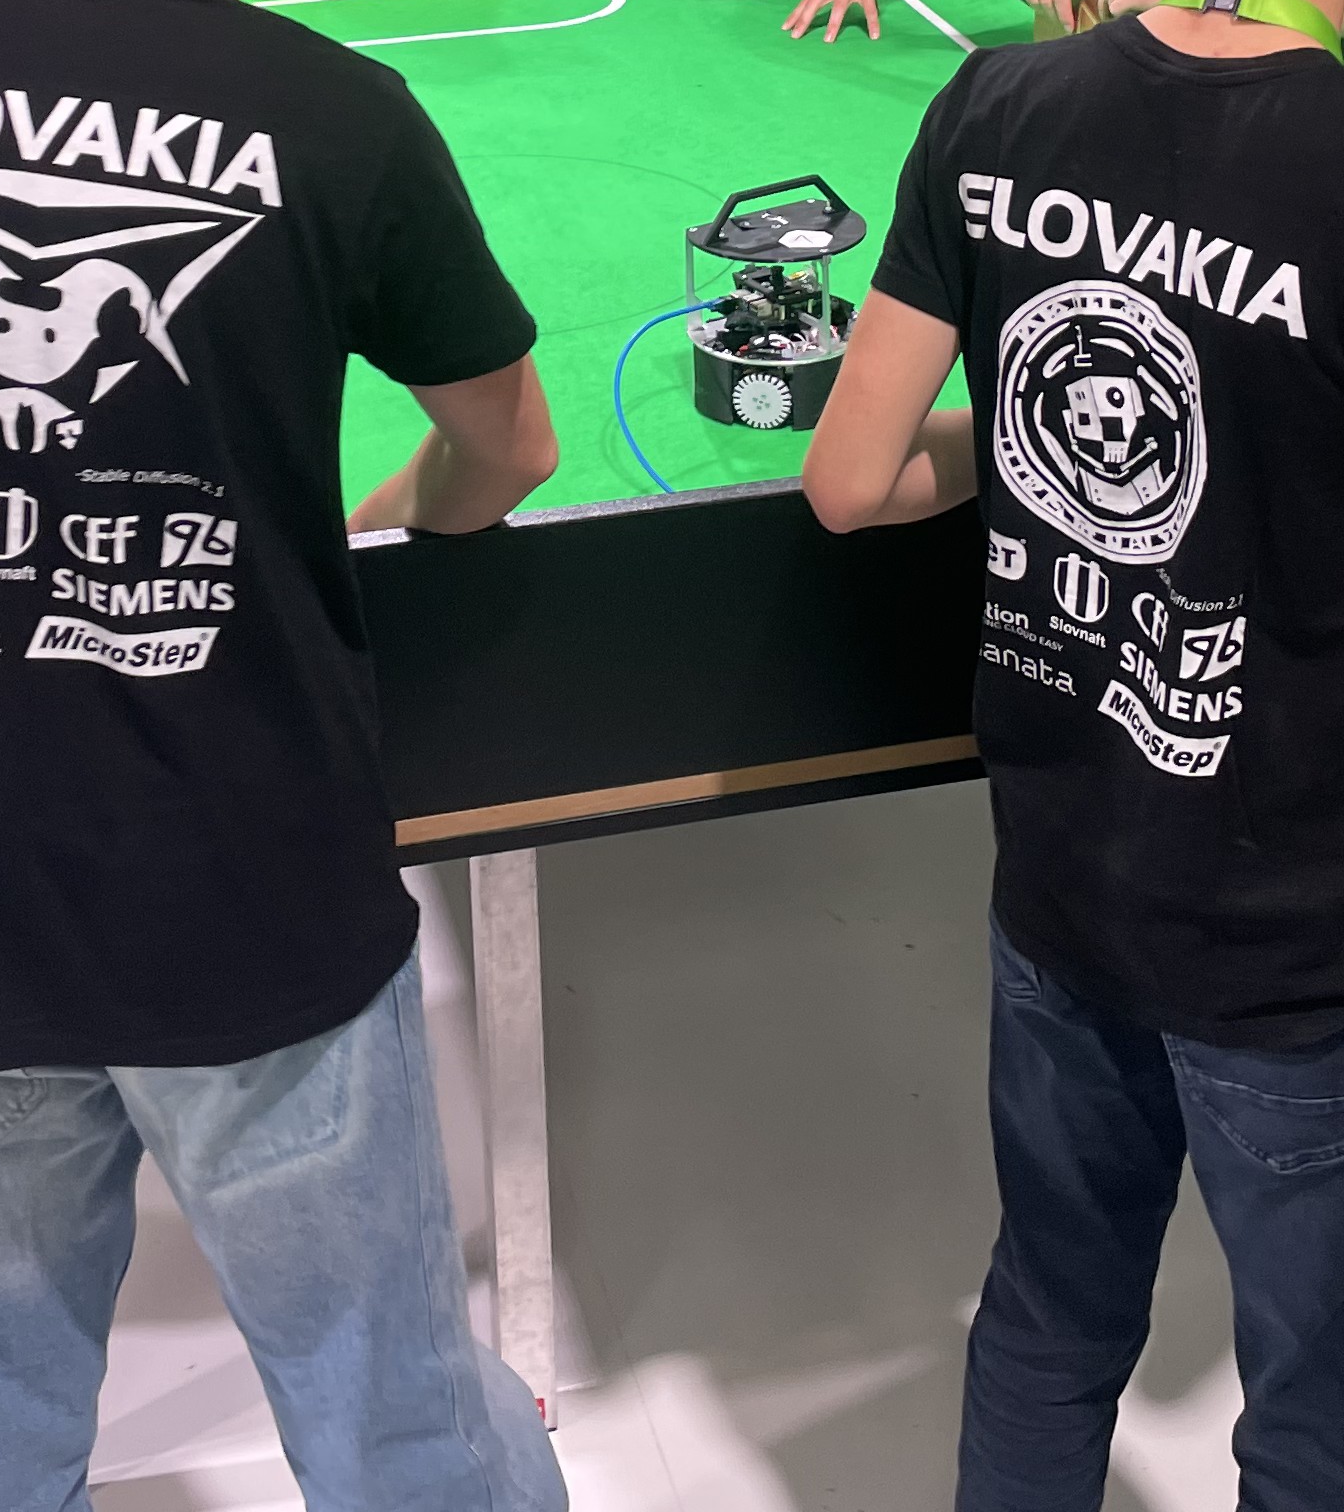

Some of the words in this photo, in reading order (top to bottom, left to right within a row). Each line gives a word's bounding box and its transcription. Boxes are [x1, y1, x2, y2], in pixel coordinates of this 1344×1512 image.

[958, 172, 1308, 340] SLOVAKIA
[52, 568, 236, 617] SIEMENS
[984, 601, 1030, 630] tion
[40, 625, 203, 669] MicroStep
[1049, 615, 1107, 649] Slovnaft
[1120, 641, 1244, 723] SIEMENS
[1108, 689, 1216, 774] MicroStep
